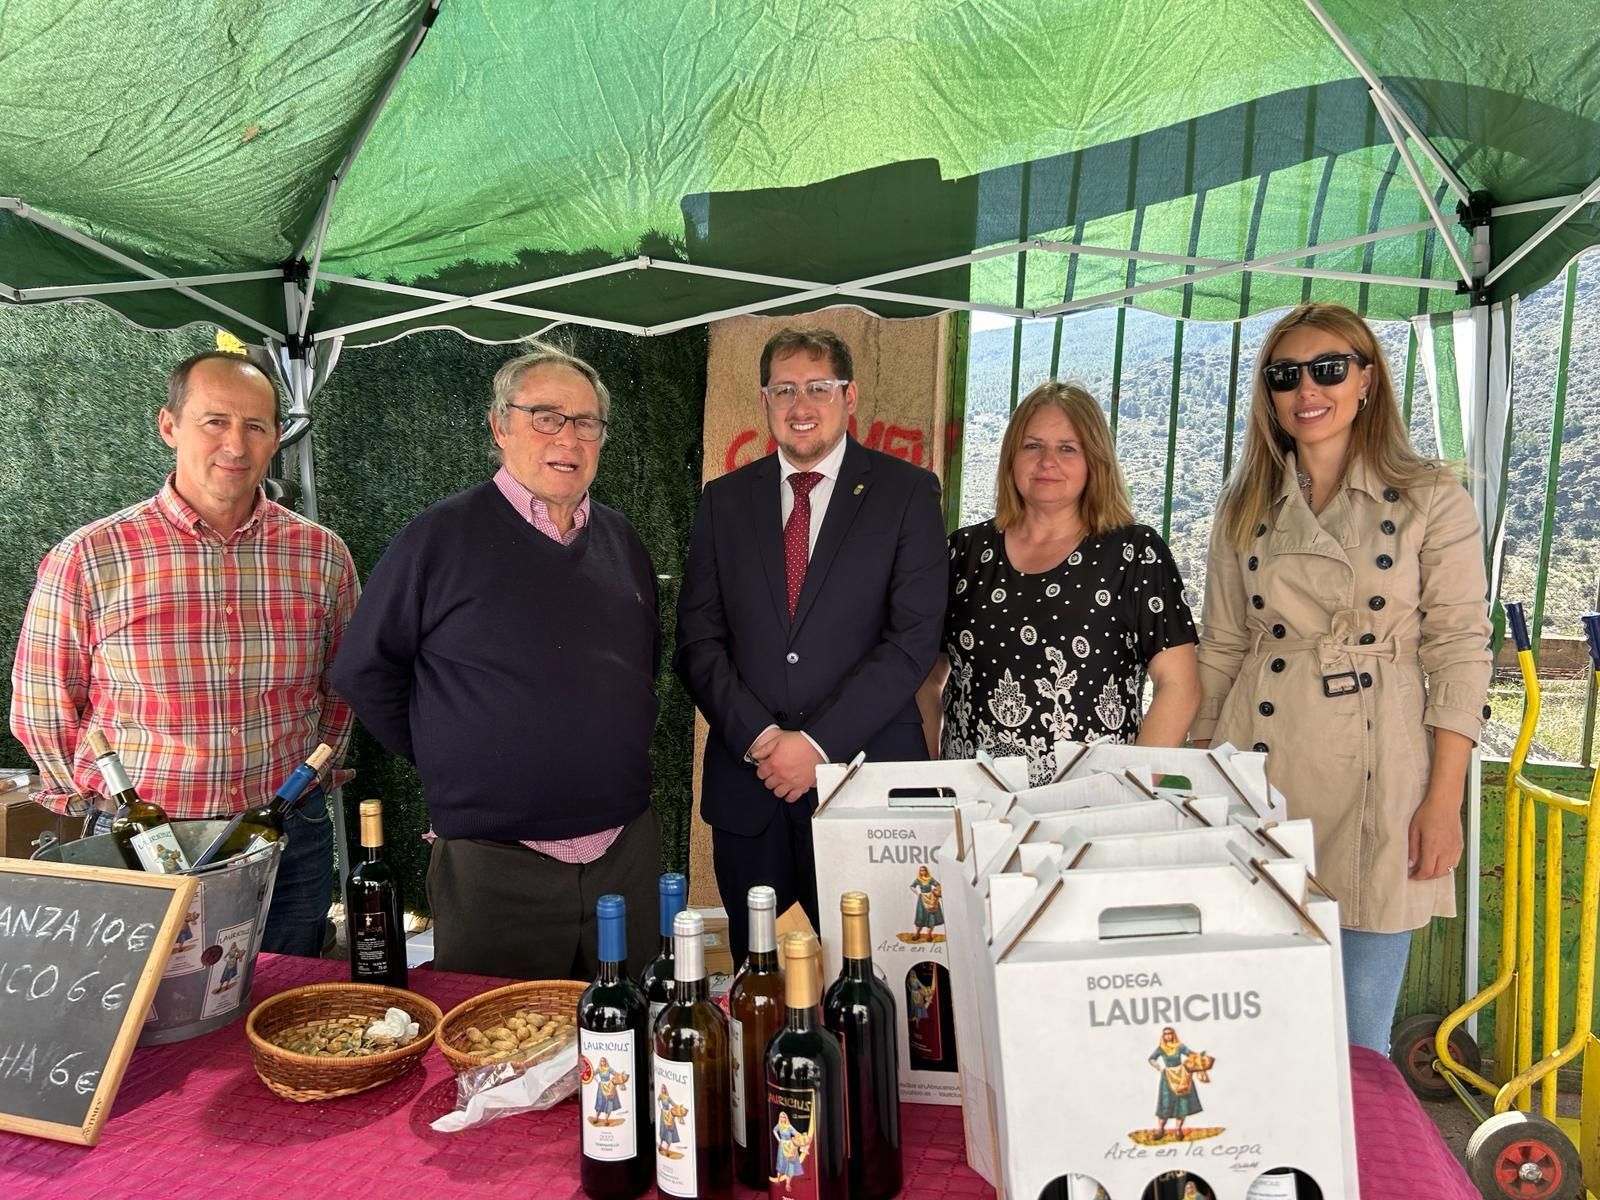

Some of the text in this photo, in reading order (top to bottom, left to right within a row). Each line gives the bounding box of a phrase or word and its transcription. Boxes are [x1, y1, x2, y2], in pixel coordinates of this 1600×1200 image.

[867, 829, 917, 840] BODEGA
[877, 940, 943, 954] Arte en la
[1086, 972, 1162, 991] BODEGA
[1088, 990, 1262, 1028] LAURICIUS
[583, 1041, 630, 1053] LAURICIUS
[1104, 1142, 1262, 1160] Arte en la copa
